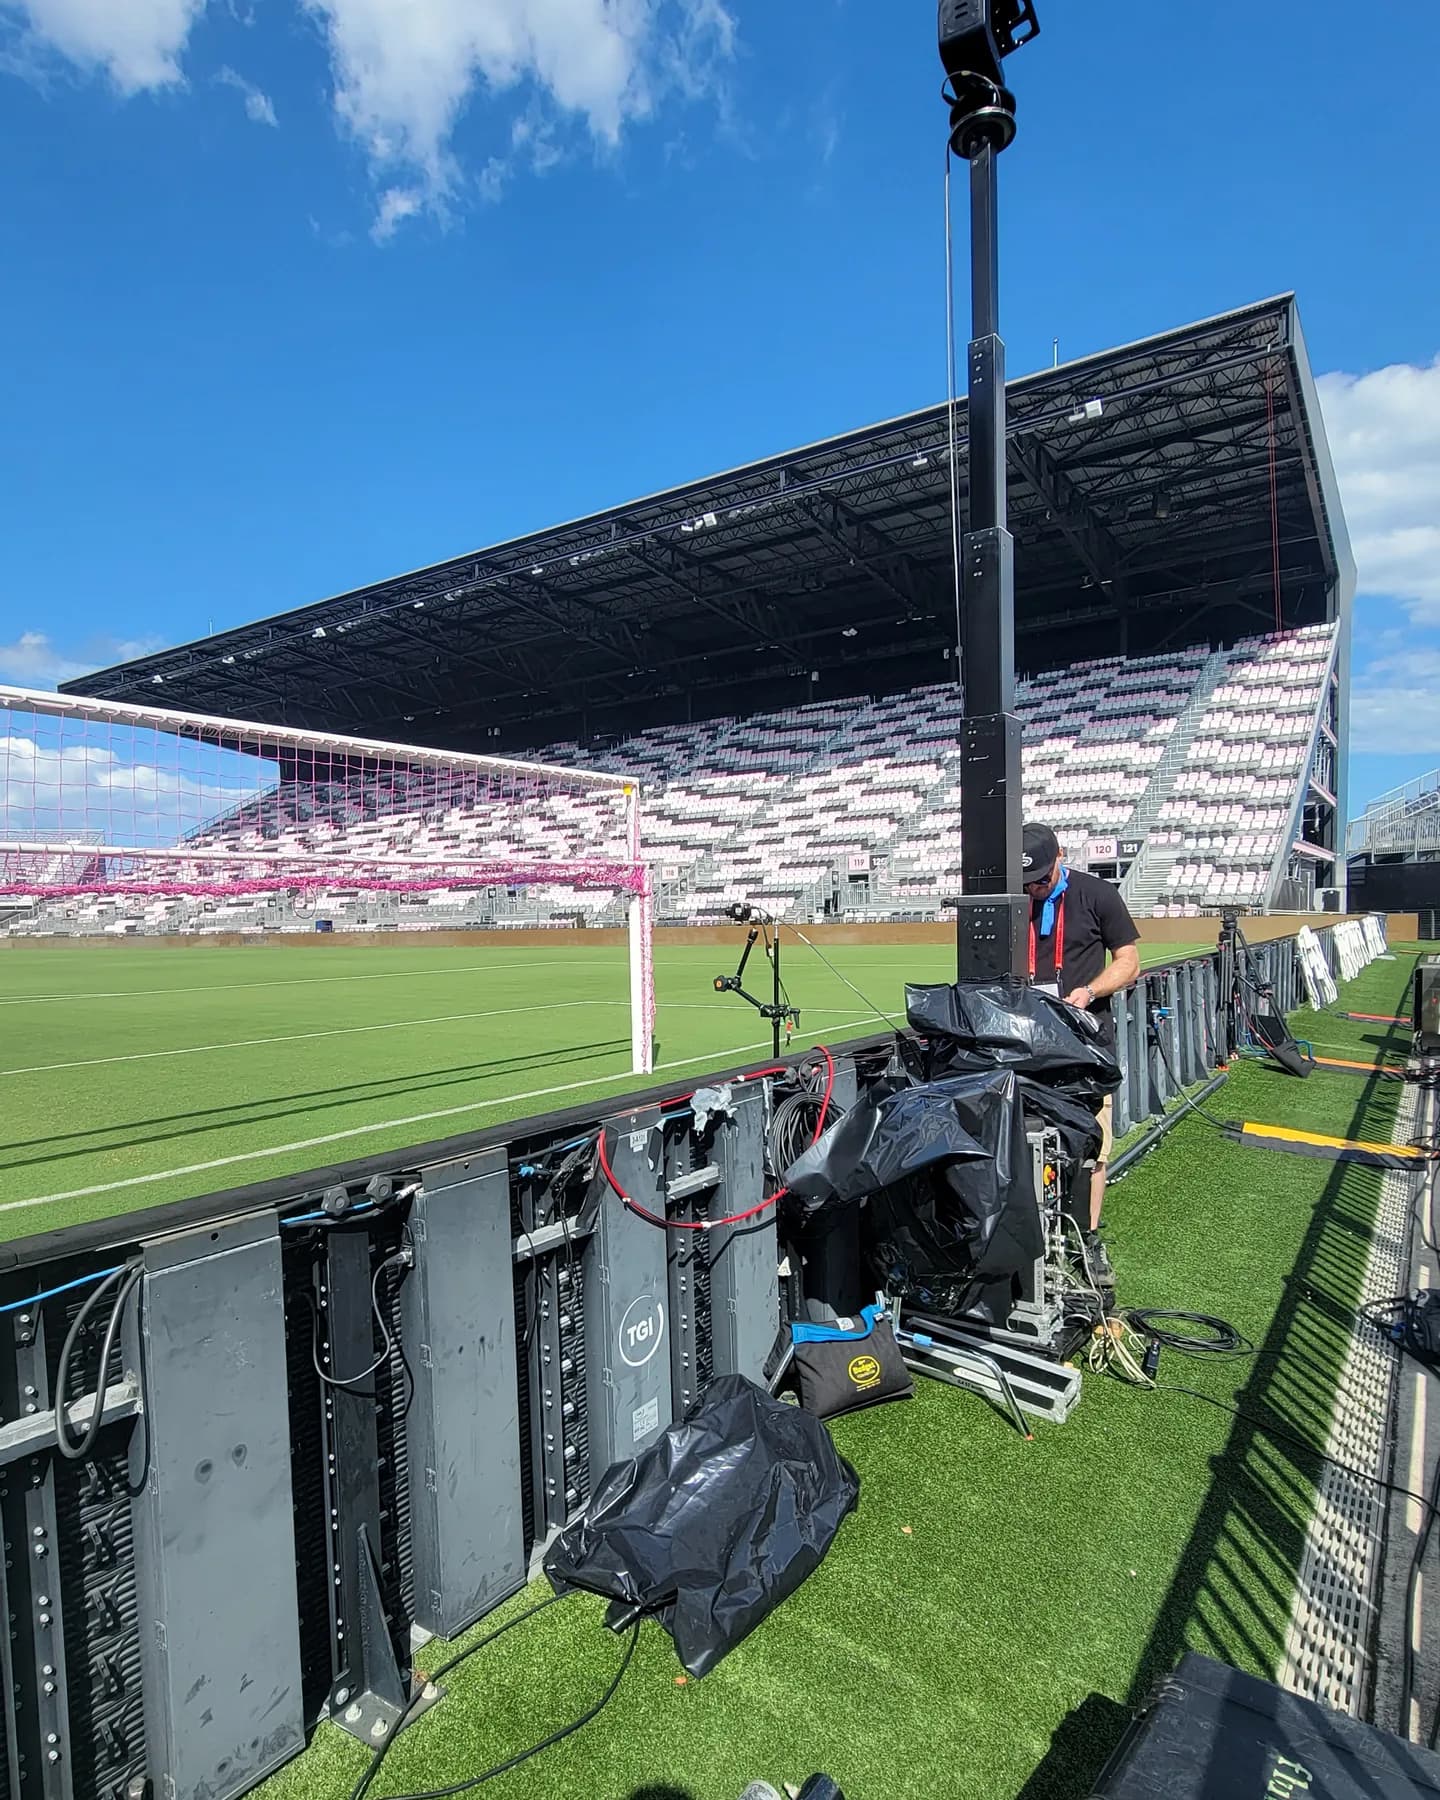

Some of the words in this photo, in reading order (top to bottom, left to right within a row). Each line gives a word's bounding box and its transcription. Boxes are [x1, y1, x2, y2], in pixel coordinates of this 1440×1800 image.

[1095, 844, 1112, 854] 120
[1122, 843, 1138, 853] 121
[626, 1316, 653, 1347] TGI
[1264, 1754, 1313, 1800] flu
